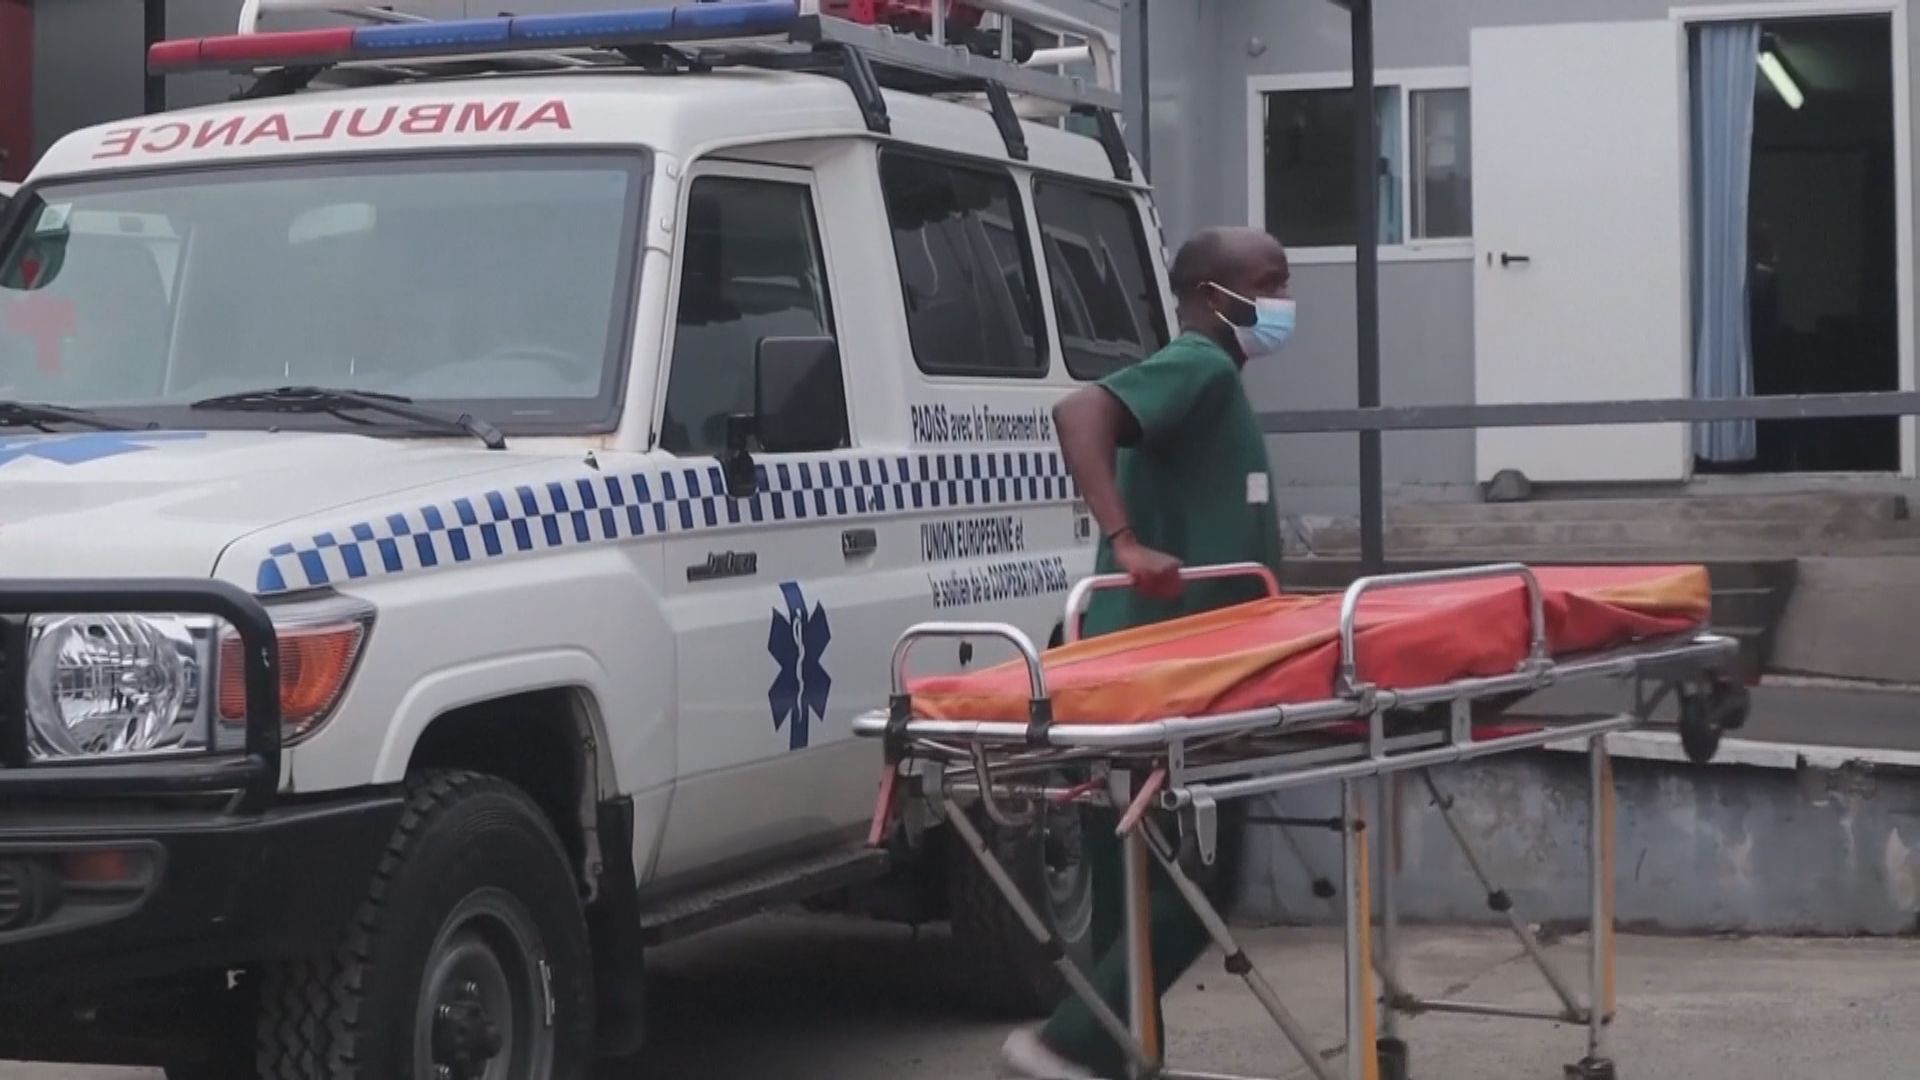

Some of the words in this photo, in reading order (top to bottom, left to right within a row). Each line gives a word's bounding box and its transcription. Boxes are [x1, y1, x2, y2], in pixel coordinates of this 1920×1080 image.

[950, 413, 972, 441] avec
[972, 405, 983, 441] le
[984, 405, 1038, 441] financement
[1038, 406, 1050, 441] de
[957, 516, 1014, 558] EUROPEENNE
[1015, 517, 1024, 551] et
[927, 572, 940, 608] le
[941, 570, 970, 607] soutien
[969, 567, 982, 603] de
[979, 567, 990, 602] la
[988, 560, 1044, 601] COOPERATION
